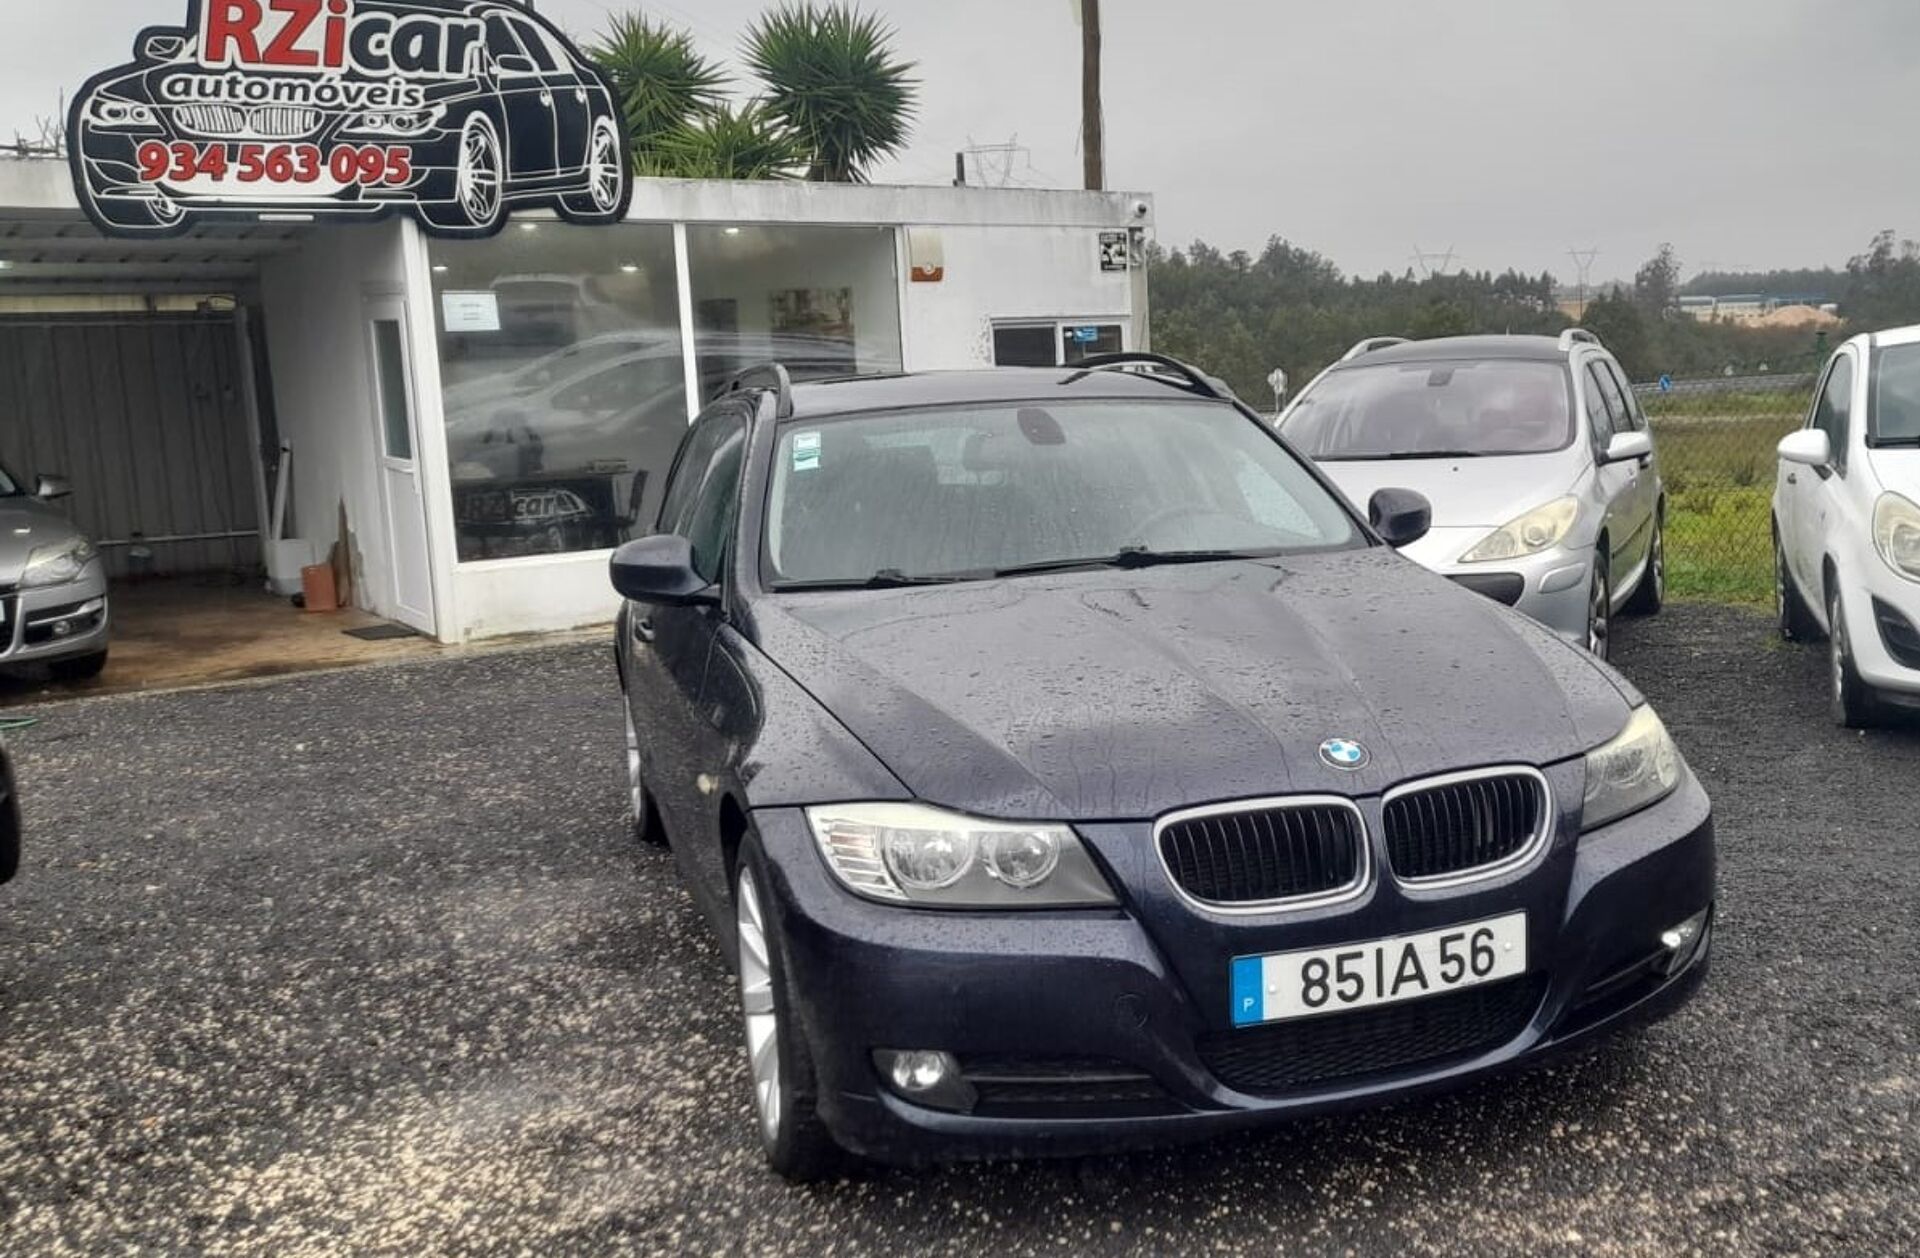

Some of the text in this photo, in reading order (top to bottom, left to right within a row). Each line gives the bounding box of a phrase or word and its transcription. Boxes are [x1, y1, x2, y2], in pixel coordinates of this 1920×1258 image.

[204, 0, 480, 72] RZicar
[166, 73, 421, 106] automóveis
[138, 143, 411, 185] 934 563 095
[1242, 999, 1254, 1012] P
